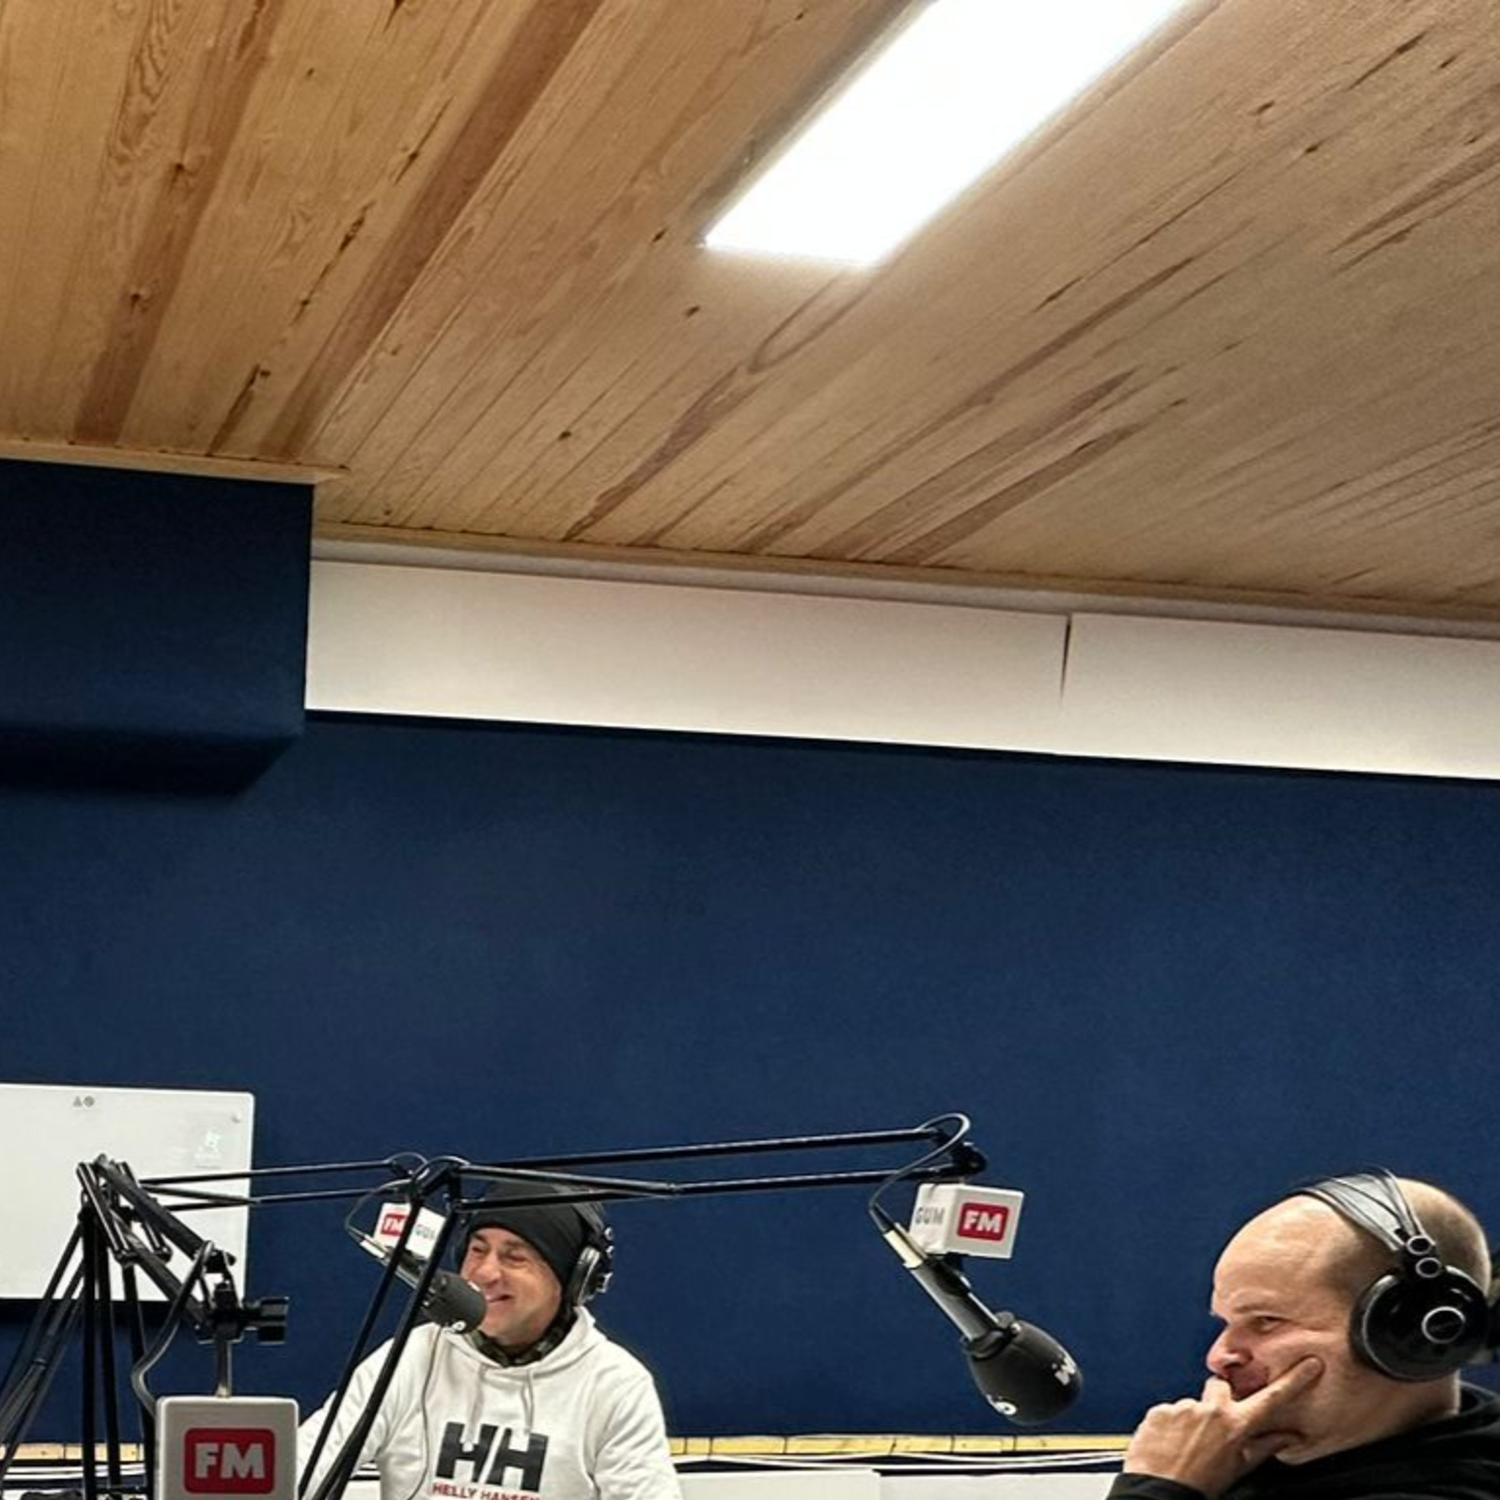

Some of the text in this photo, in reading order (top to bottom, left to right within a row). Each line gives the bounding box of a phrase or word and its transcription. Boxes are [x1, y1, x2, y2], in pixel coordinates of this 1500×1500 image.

[963, 1209, 1004, 1234] FM
[194, 1442, 266, 1479] FM
[435, 1421, 549, 1493] HH
[432, 1482, 478, 1500] HELLY
